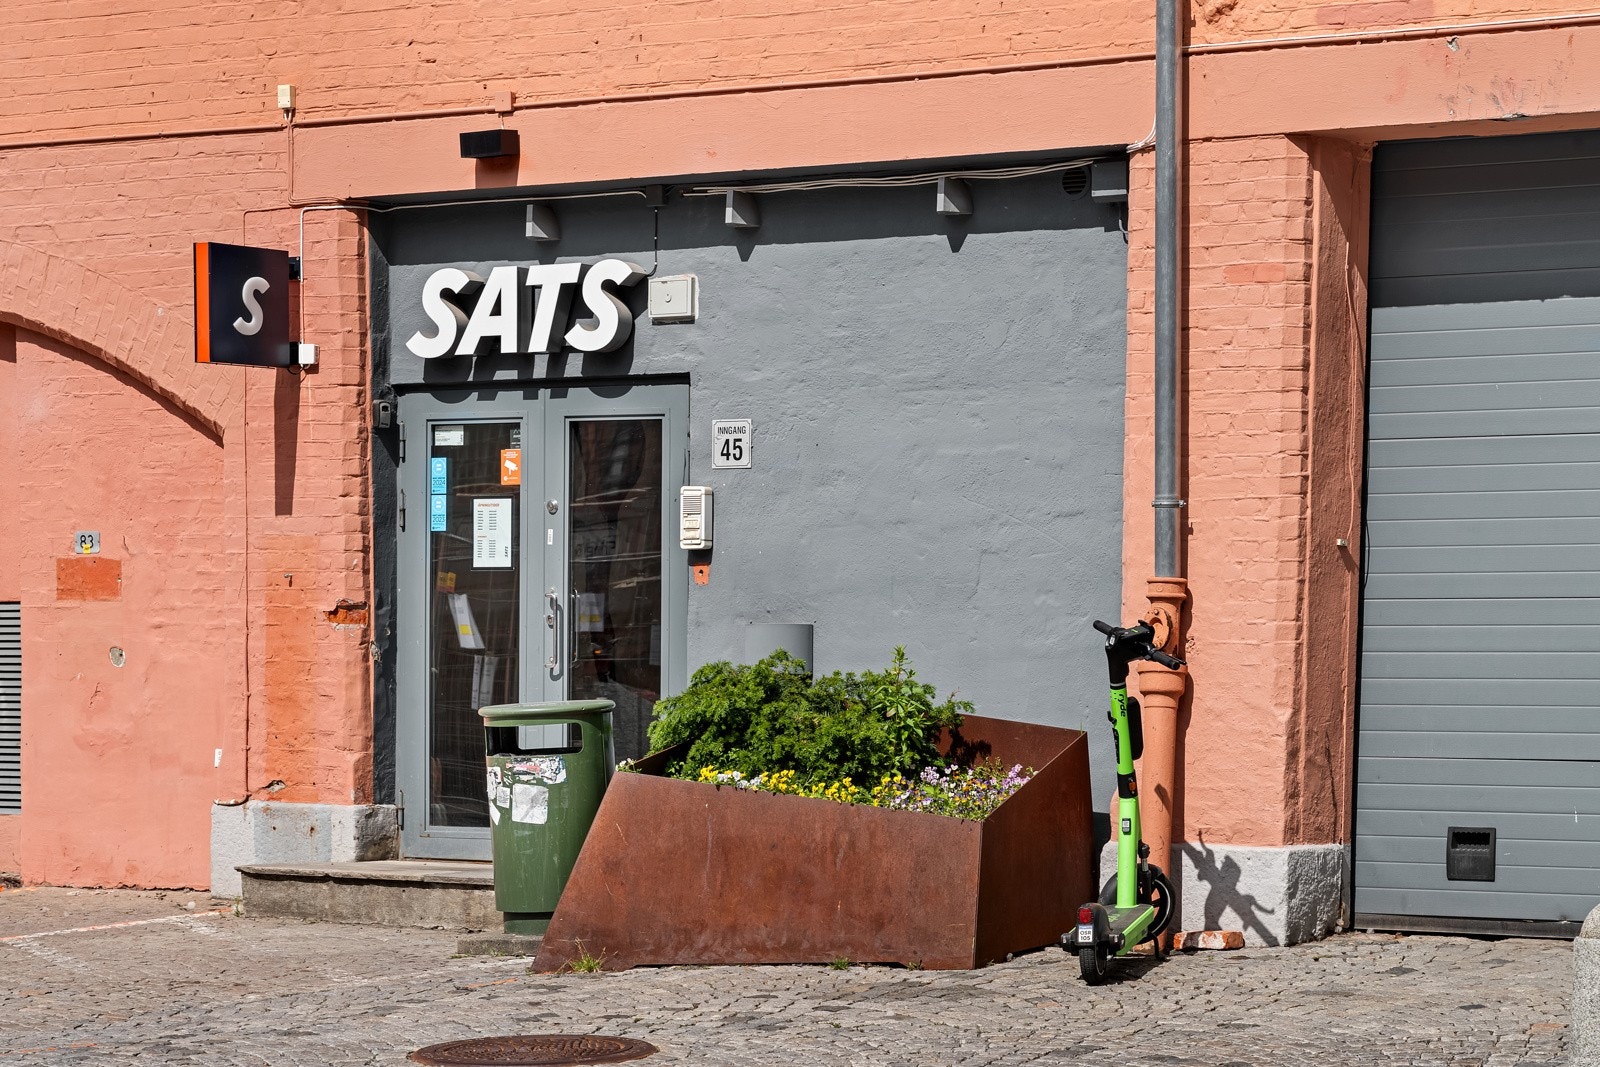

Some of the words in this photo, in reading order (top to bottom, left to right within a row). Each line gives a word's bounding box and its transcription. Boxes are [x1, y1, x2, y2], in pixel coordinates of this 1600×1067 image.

[233, 276, 270, 336] S
[405, 258, 634, 359] SATS
[717, 425, 747, 435] INNGANG
[720, 438, 743, 461] 45
[80, 534, 94, 549] 83
[1118, 693, 1126, 717] ryde
